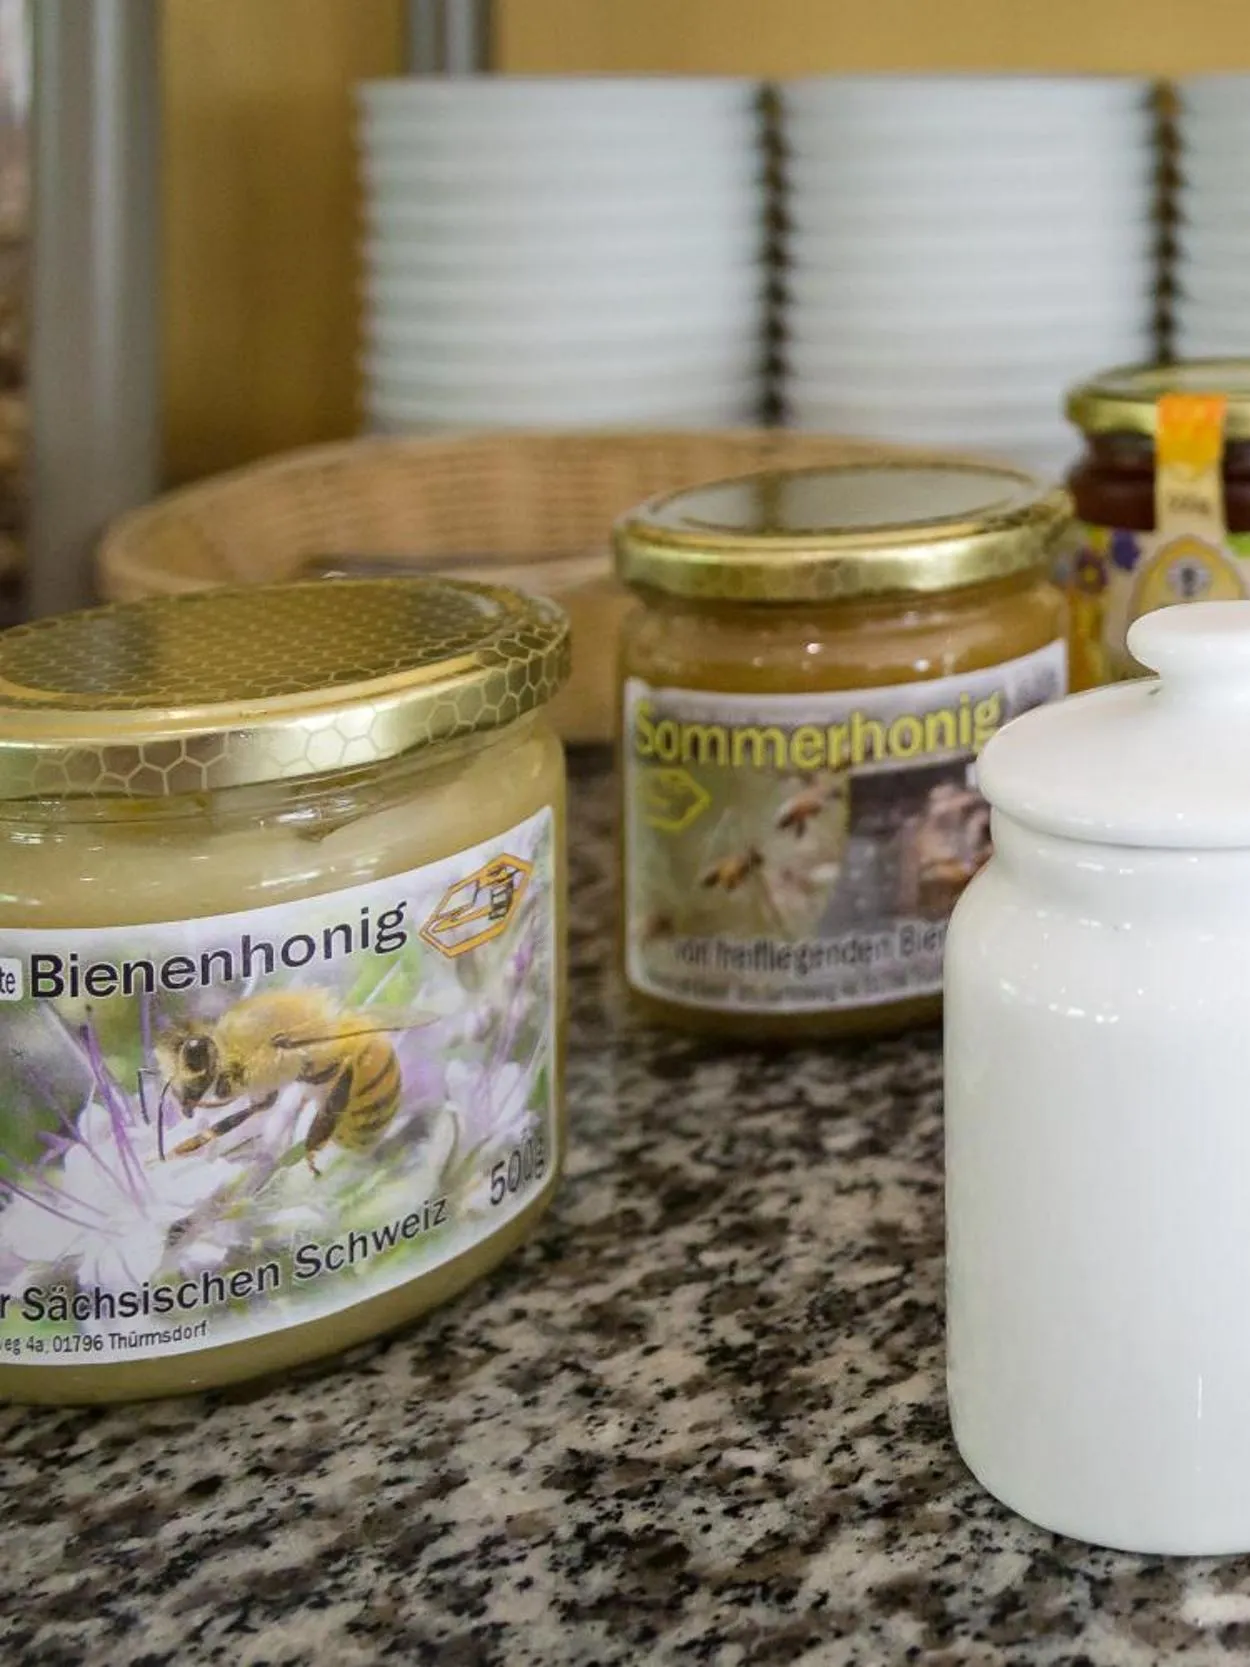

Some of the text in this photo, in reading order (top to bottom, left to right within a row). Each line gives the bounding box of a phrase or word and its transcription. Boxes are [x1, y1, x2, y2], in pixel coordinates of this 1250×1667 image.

[634, 691, 1001, 770] Sommerhonig
[30, 900, 408, 998] Bienenhonig
[21, 1263, 281, 1322] Sächsischen
[292, 1199, 447, 1280] Schweiz
[52, 1335, 104, 1353] 01796
[109, 1320, 208, 1350] Thürmsdorf
